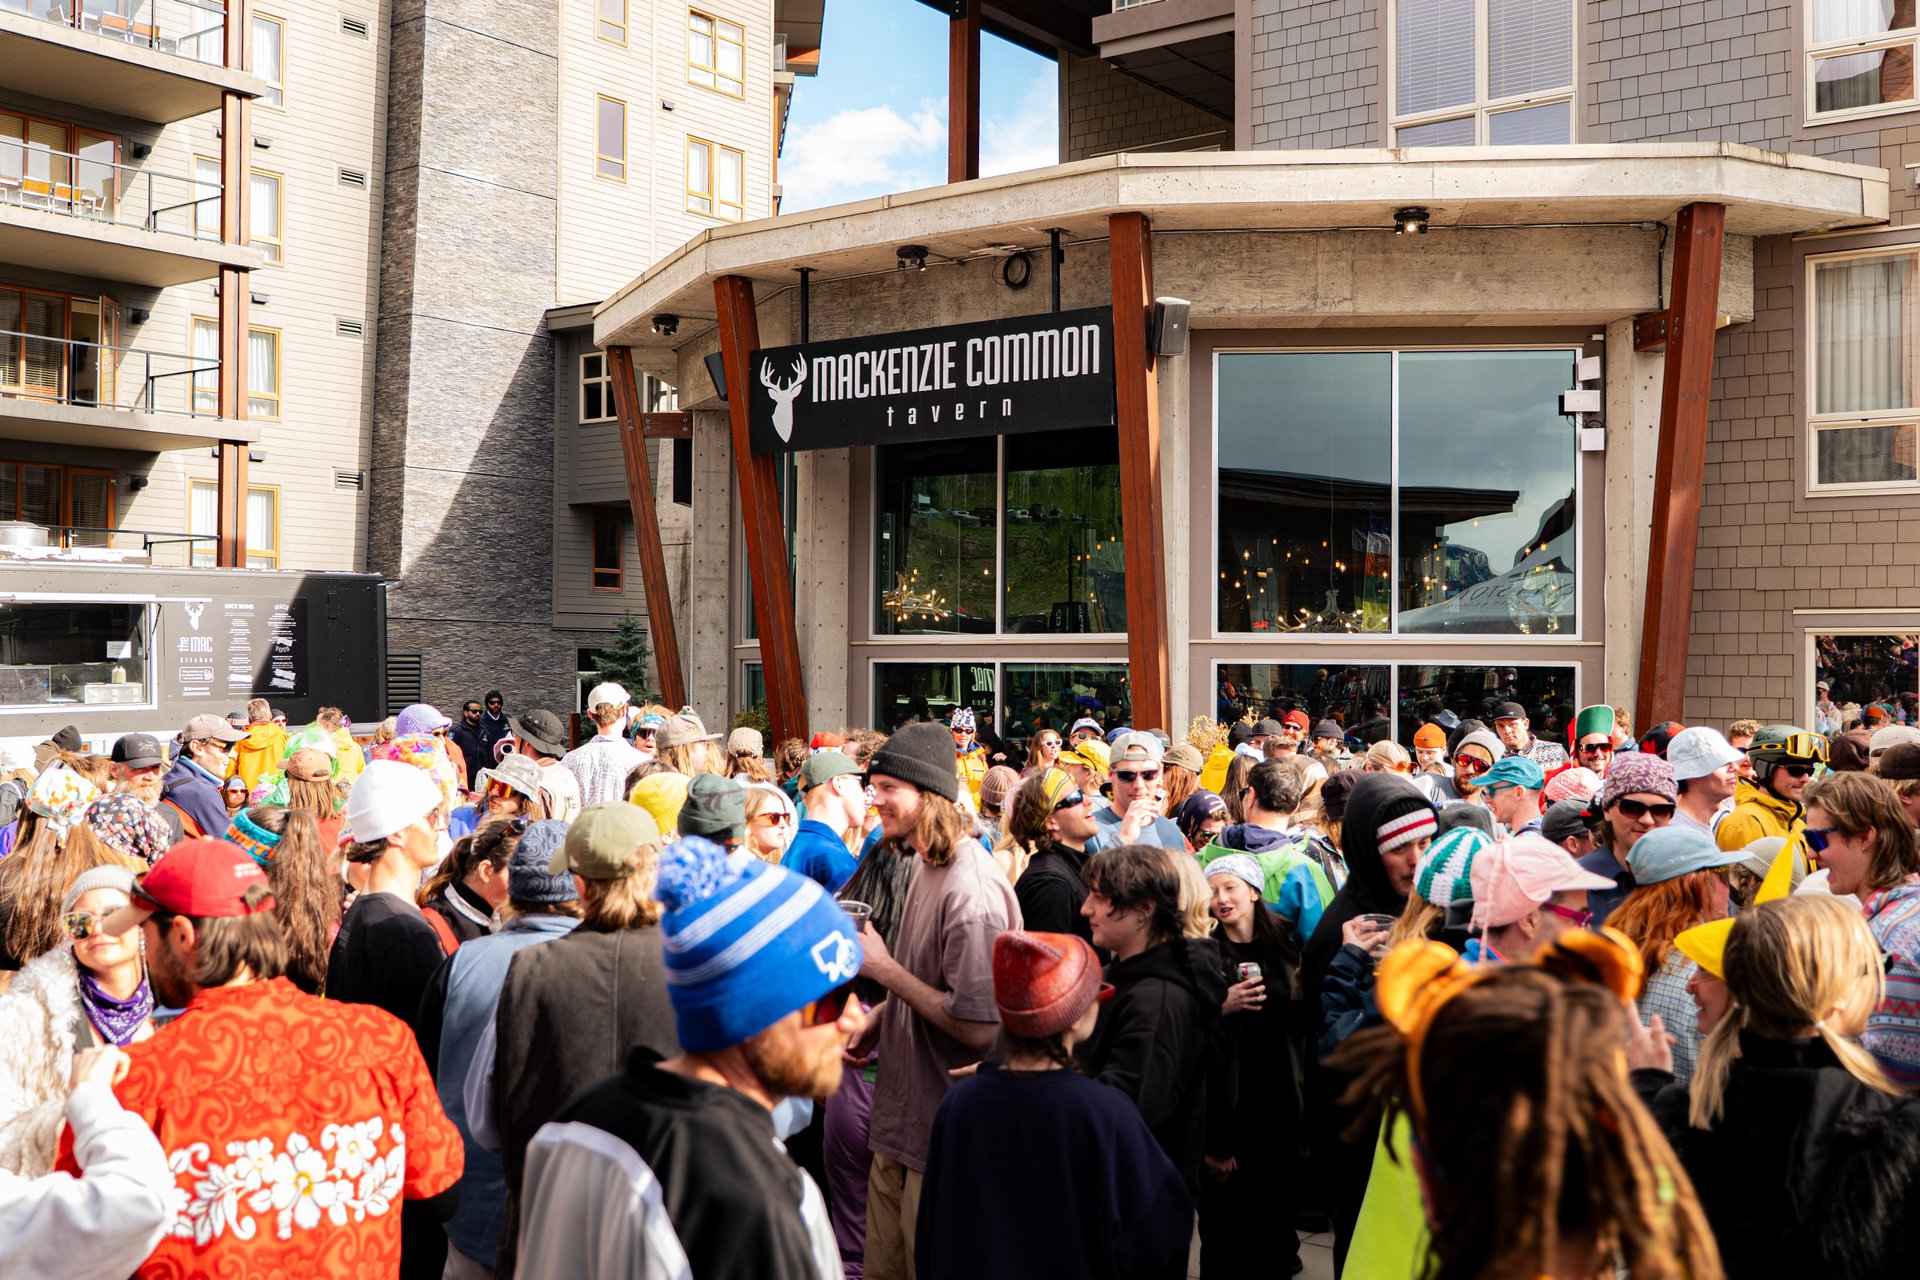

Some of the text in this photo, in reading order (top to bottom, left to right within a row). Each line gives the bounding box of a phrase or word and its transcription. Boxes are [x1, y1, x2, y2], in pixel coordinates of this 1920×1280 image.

[812, 324, 1100, 403] MACKENZIE COMMON
[887, 398, 1012, 427] tavern
[177, 637, 189, 652] the
[190, 637, 213, 652] MAC
